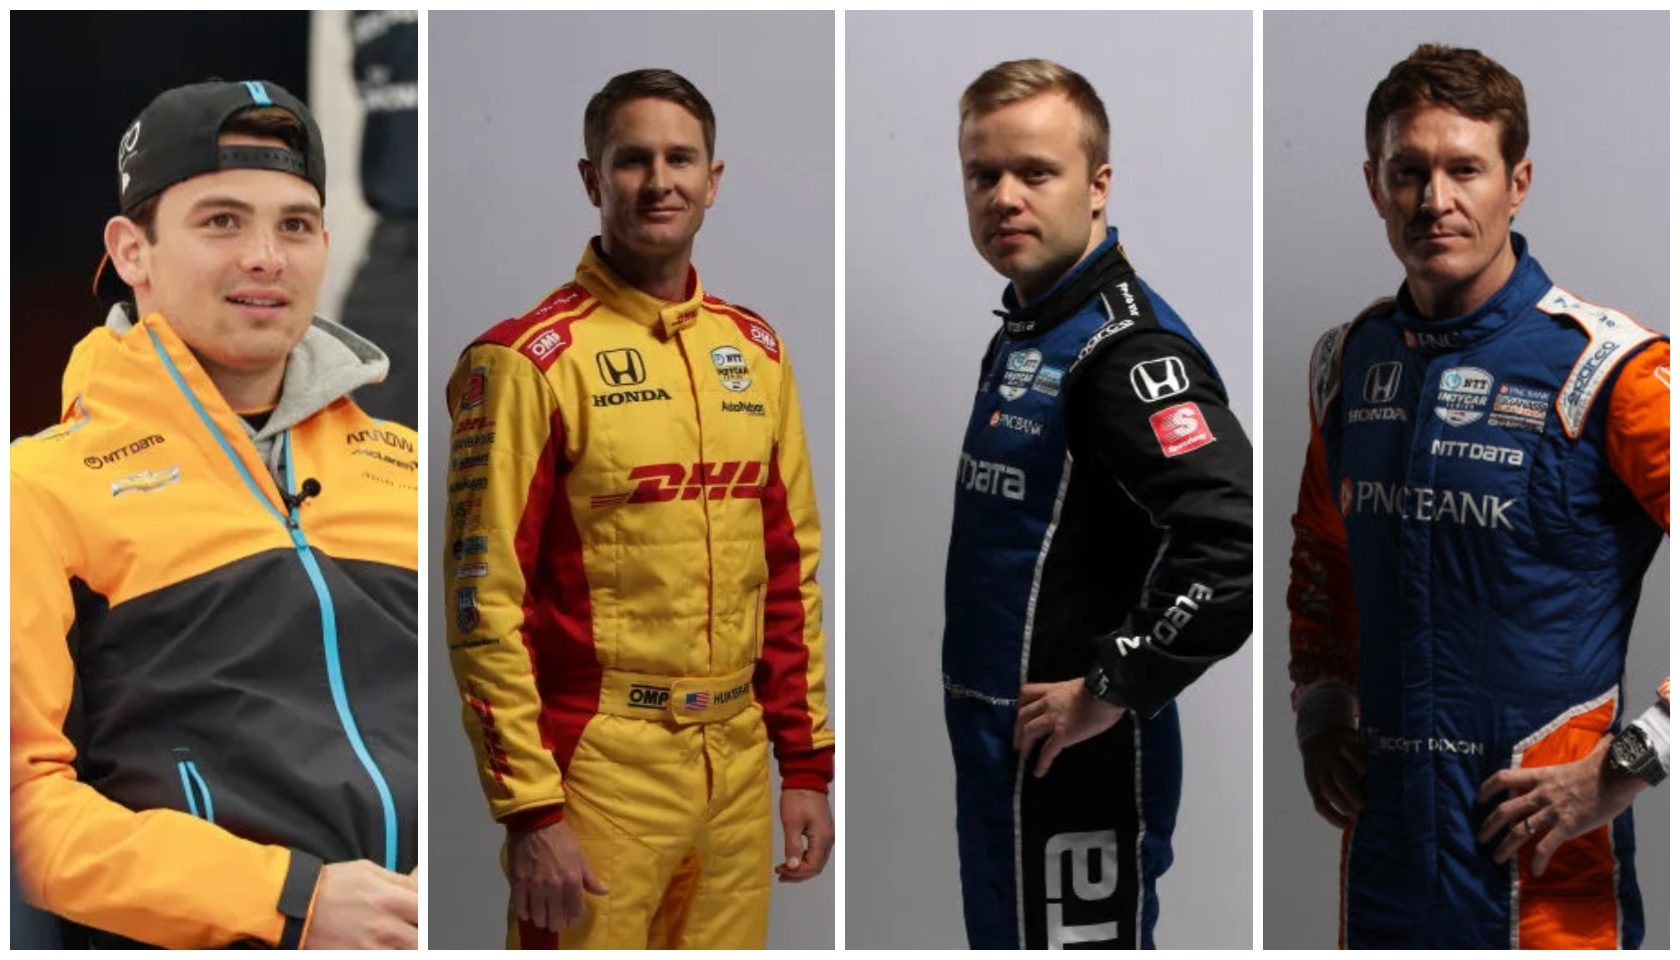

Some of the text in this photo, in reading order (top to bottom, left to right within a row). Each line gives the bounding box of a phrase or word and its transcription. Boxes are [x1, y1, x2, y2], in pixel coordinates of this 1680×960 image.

[1463, 379, 1488, 390] NTT
[592, 388, 672, 407] HONDA
[1348, 406, 1407, 423] HONDA
[624, 462, 768, 504] DHL
[630, 688, 670, 706] OMP
[1378, 736, 1485, 756] SCOTT DIXON
